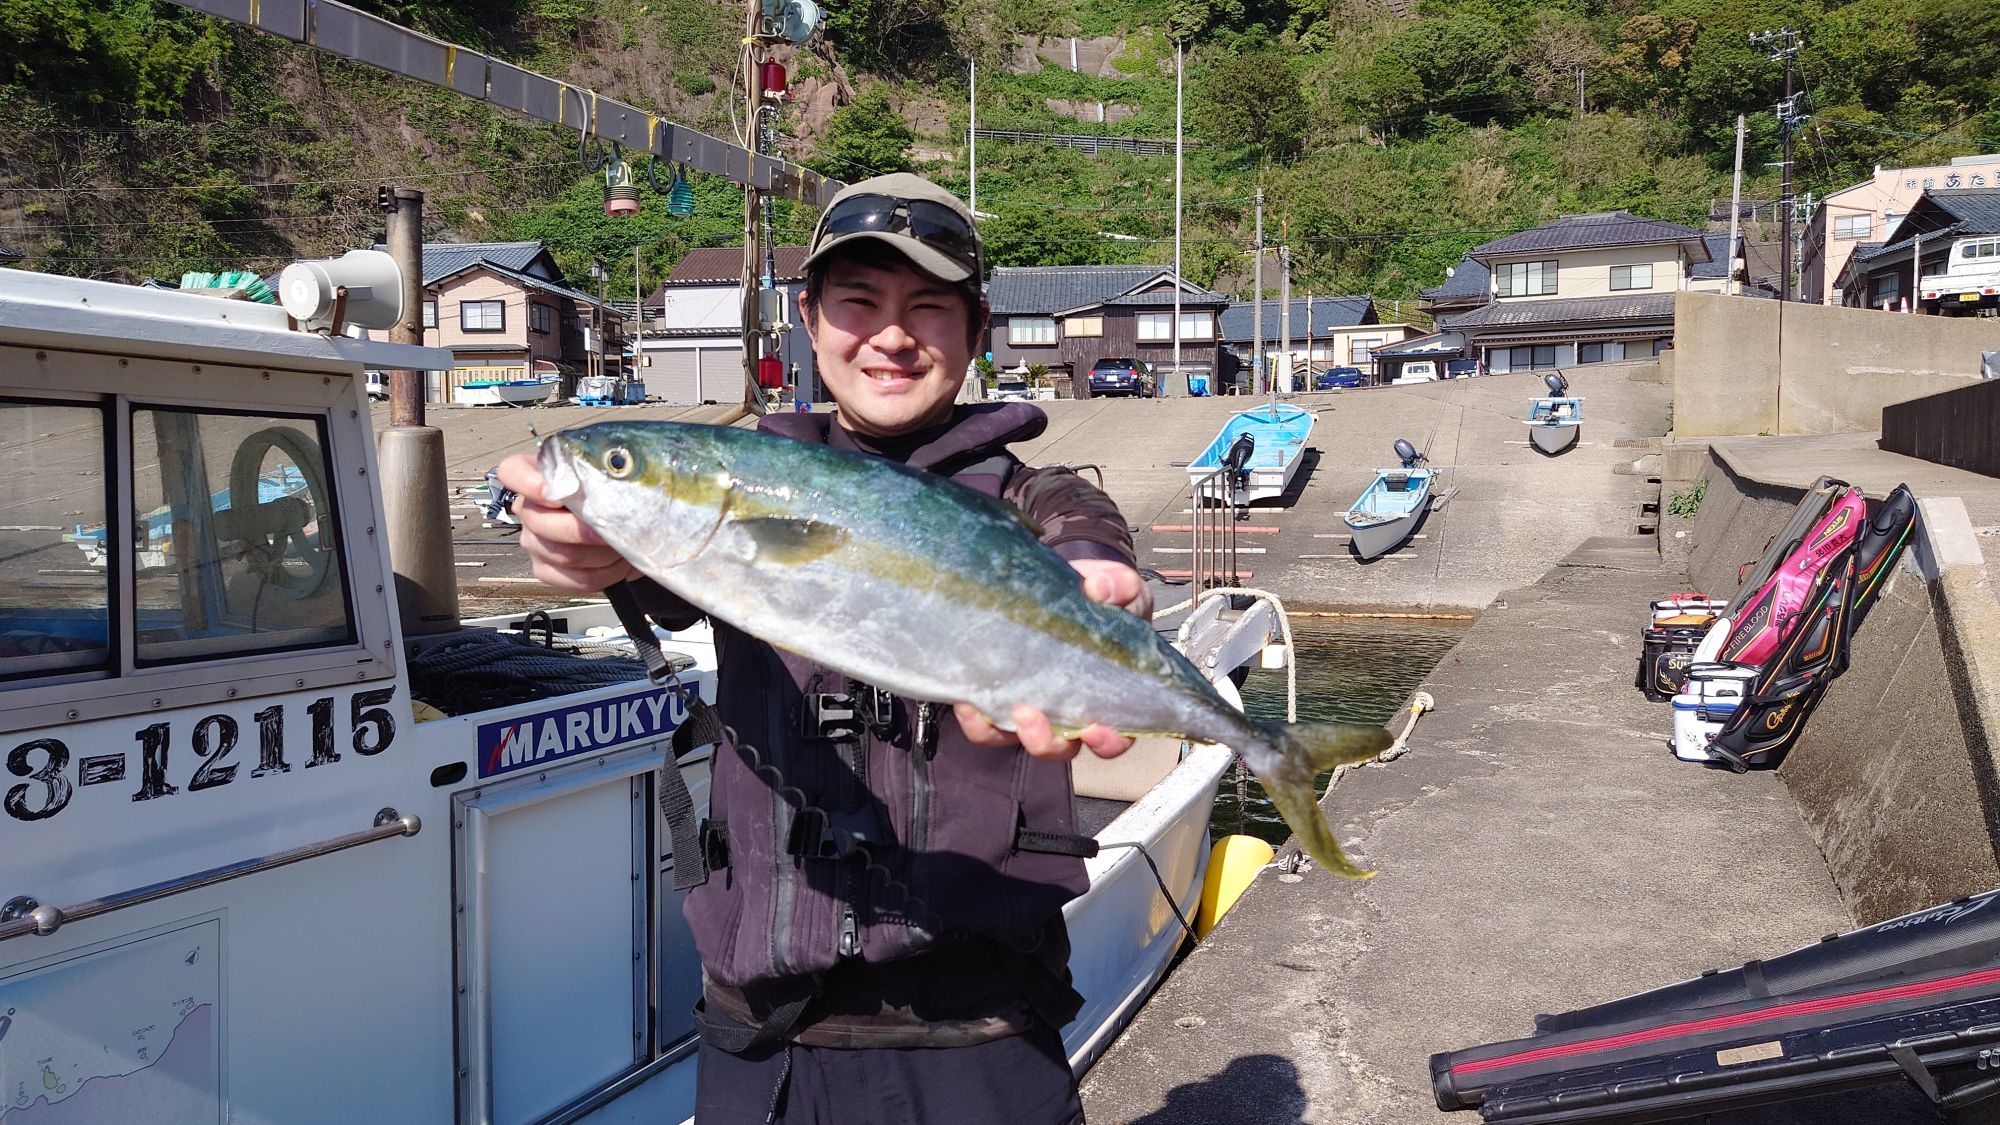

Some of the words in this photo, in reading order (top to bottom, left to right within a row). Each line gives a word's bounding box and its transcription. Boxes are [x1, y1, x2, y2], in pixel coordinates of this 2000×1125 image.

[1823, 515, 1844, 536] NEXUS
[1729, 631, 1747, 650] FIRE
[1743, 605, 1768, 634] BLOOD
[4, 685, 396, 821] 3-12115
[500, 689, 690, 768] MARUKYU
